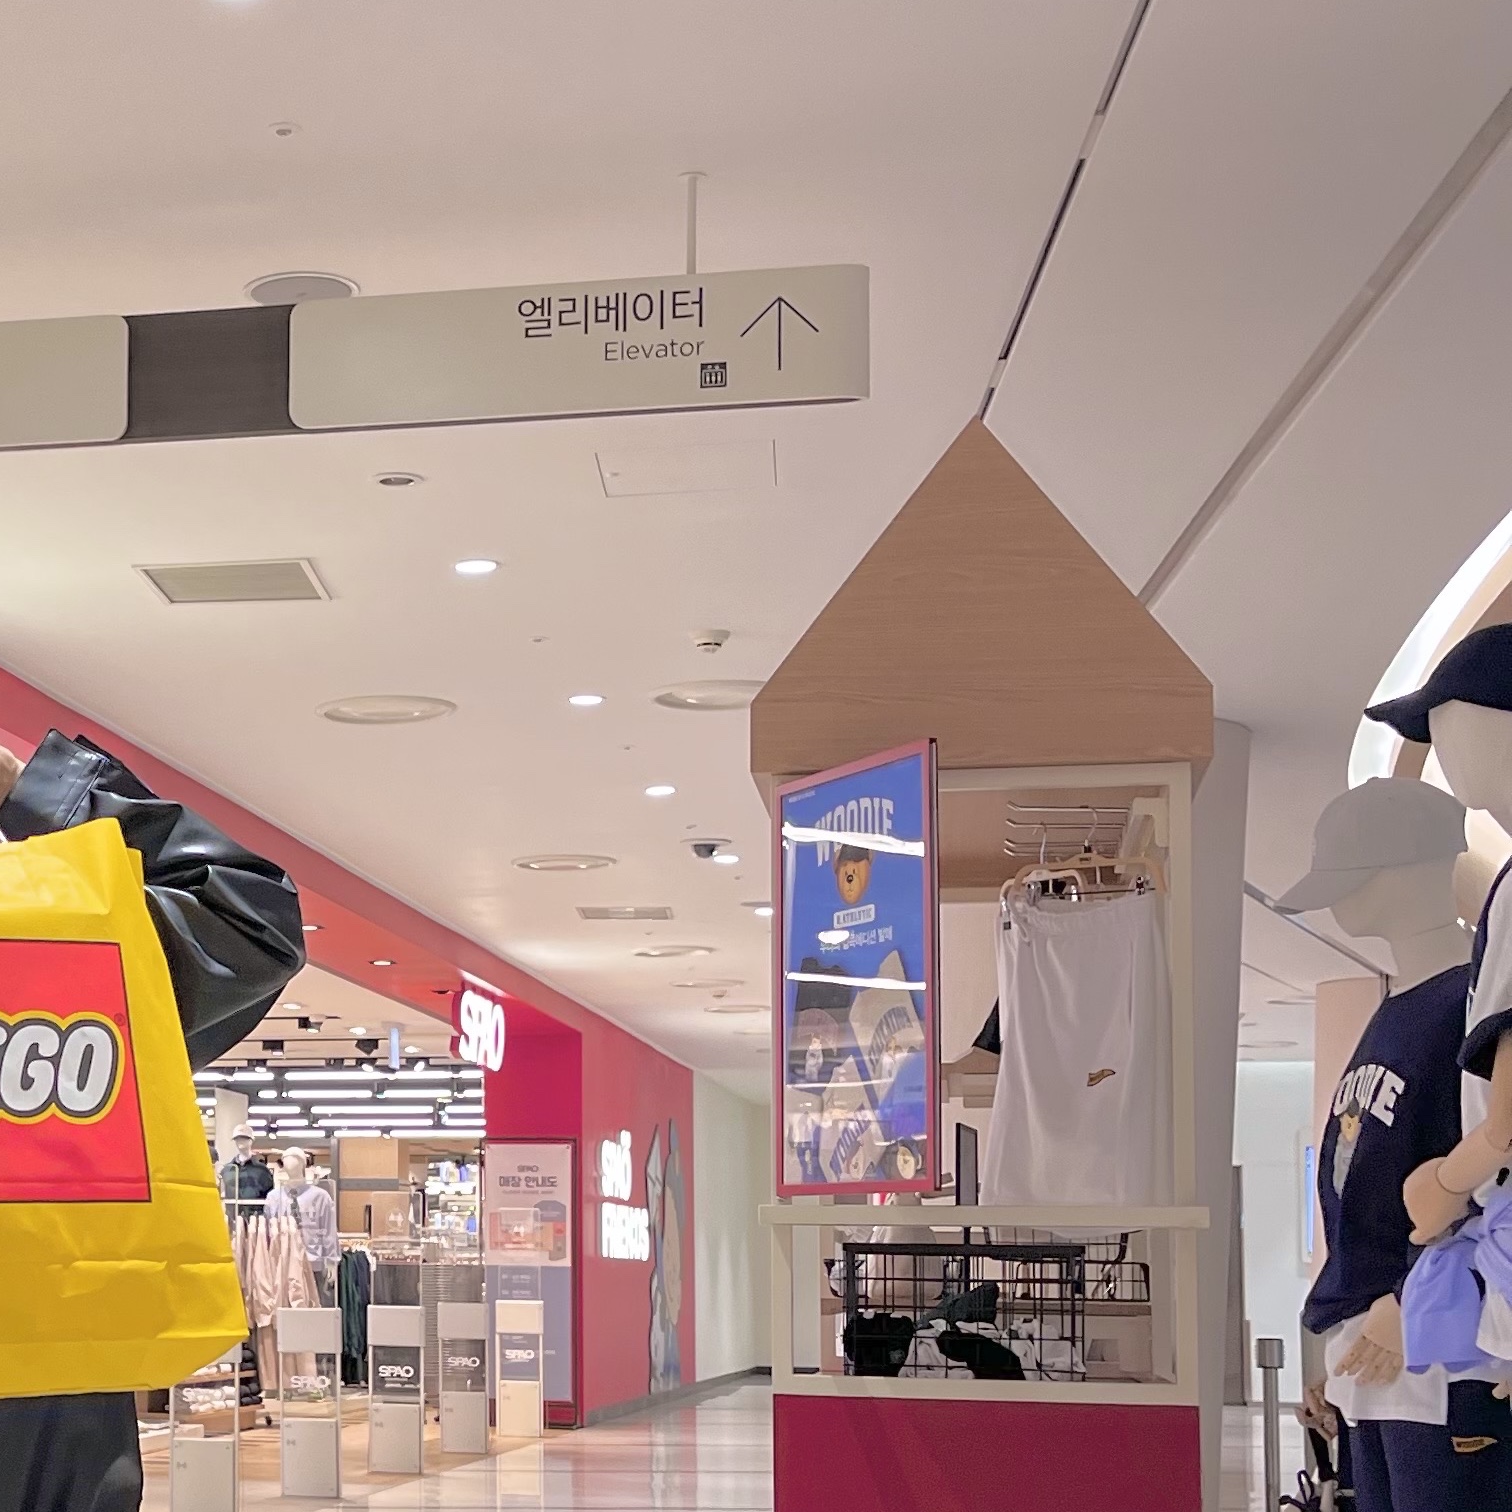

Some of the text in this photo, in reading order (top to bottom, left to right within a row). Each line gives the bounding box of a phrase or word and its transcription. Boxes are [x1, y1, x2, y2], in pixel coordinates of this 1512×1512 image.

[518, 287, 703, 338] 엘리베이터
[604, 339, 705, 361] Elevator
[459, 989, 506, 1072] SPAO
[290, 1375, 330, 1389] SPAO
[378, 1365, 415, 1378] SPAO
